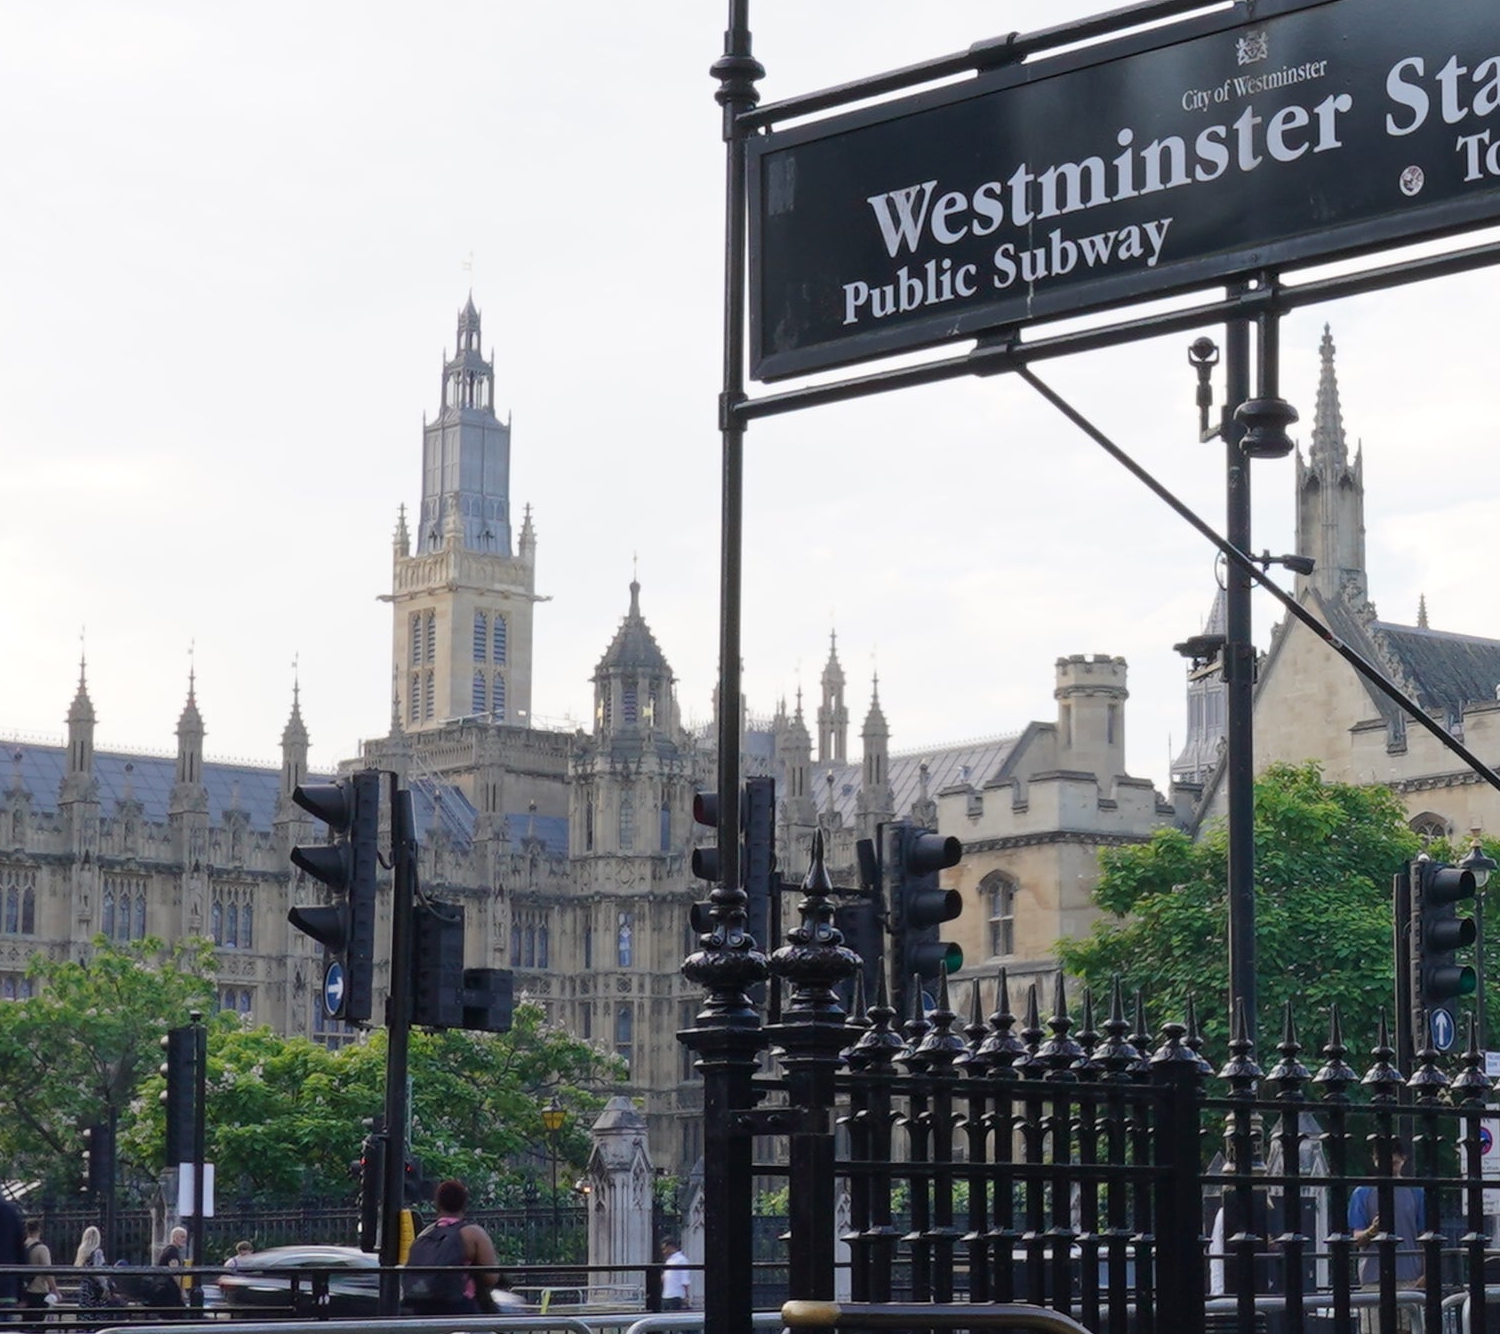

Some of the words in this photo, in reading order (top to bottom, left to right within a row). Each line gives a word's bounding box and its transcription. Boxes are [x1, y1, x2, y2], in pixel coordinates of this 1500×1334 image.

[1181, 89, 1211, 112] City
[1214, 79, 1231, 103] of
[1234, 60, 1328, 97] Westminster
[867, 92, 1354, 259] Westminster
[842, 258, 978, 326] Public
[993, 217, 1174, 289] Subway
